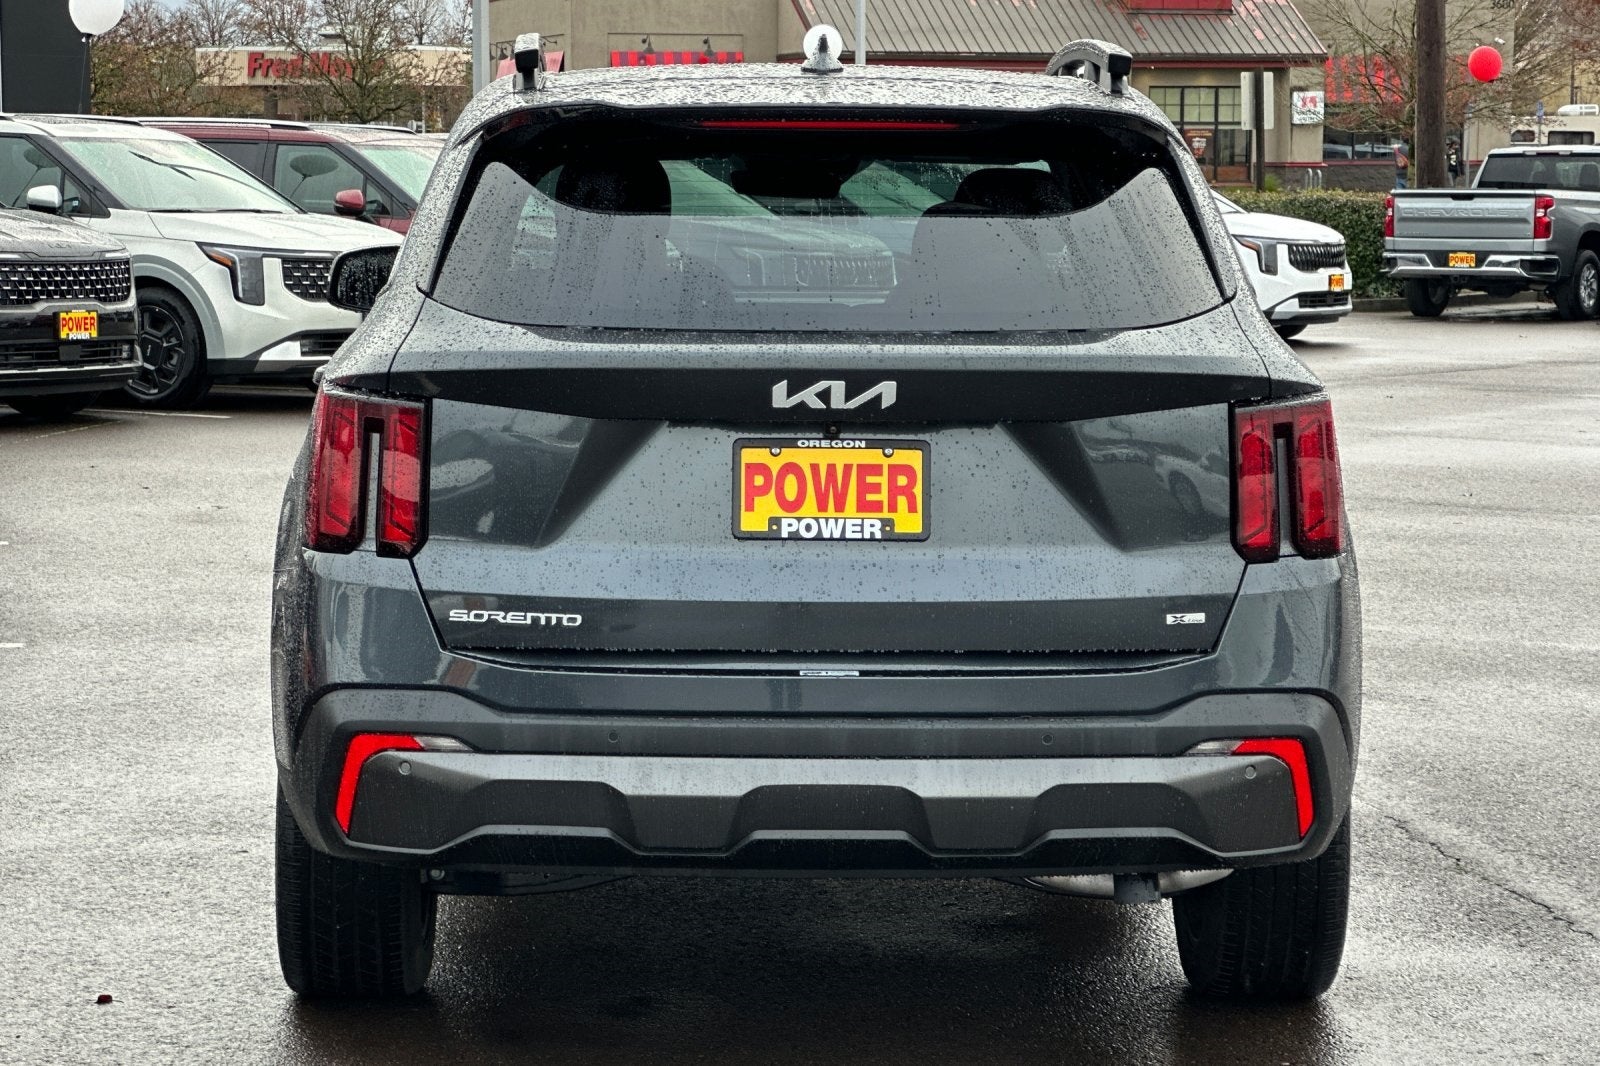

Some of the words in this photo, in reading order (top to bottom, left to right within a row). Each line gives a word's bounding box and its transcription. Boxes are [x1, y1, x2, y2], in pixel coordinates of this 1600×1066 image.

[247, 52, 304, 78] Fred
[1401, 207, 1525, 217] CHEVROLET
[61, 316, 96, 331] POWER
[772, 379, 897, 410] KIA
[797, 440, 866, 448] OREGON
[744, 461, 918, 514] POWER
[781, 518, 882, 539] POWER
[449, 609, 582, 626] SORENTO
